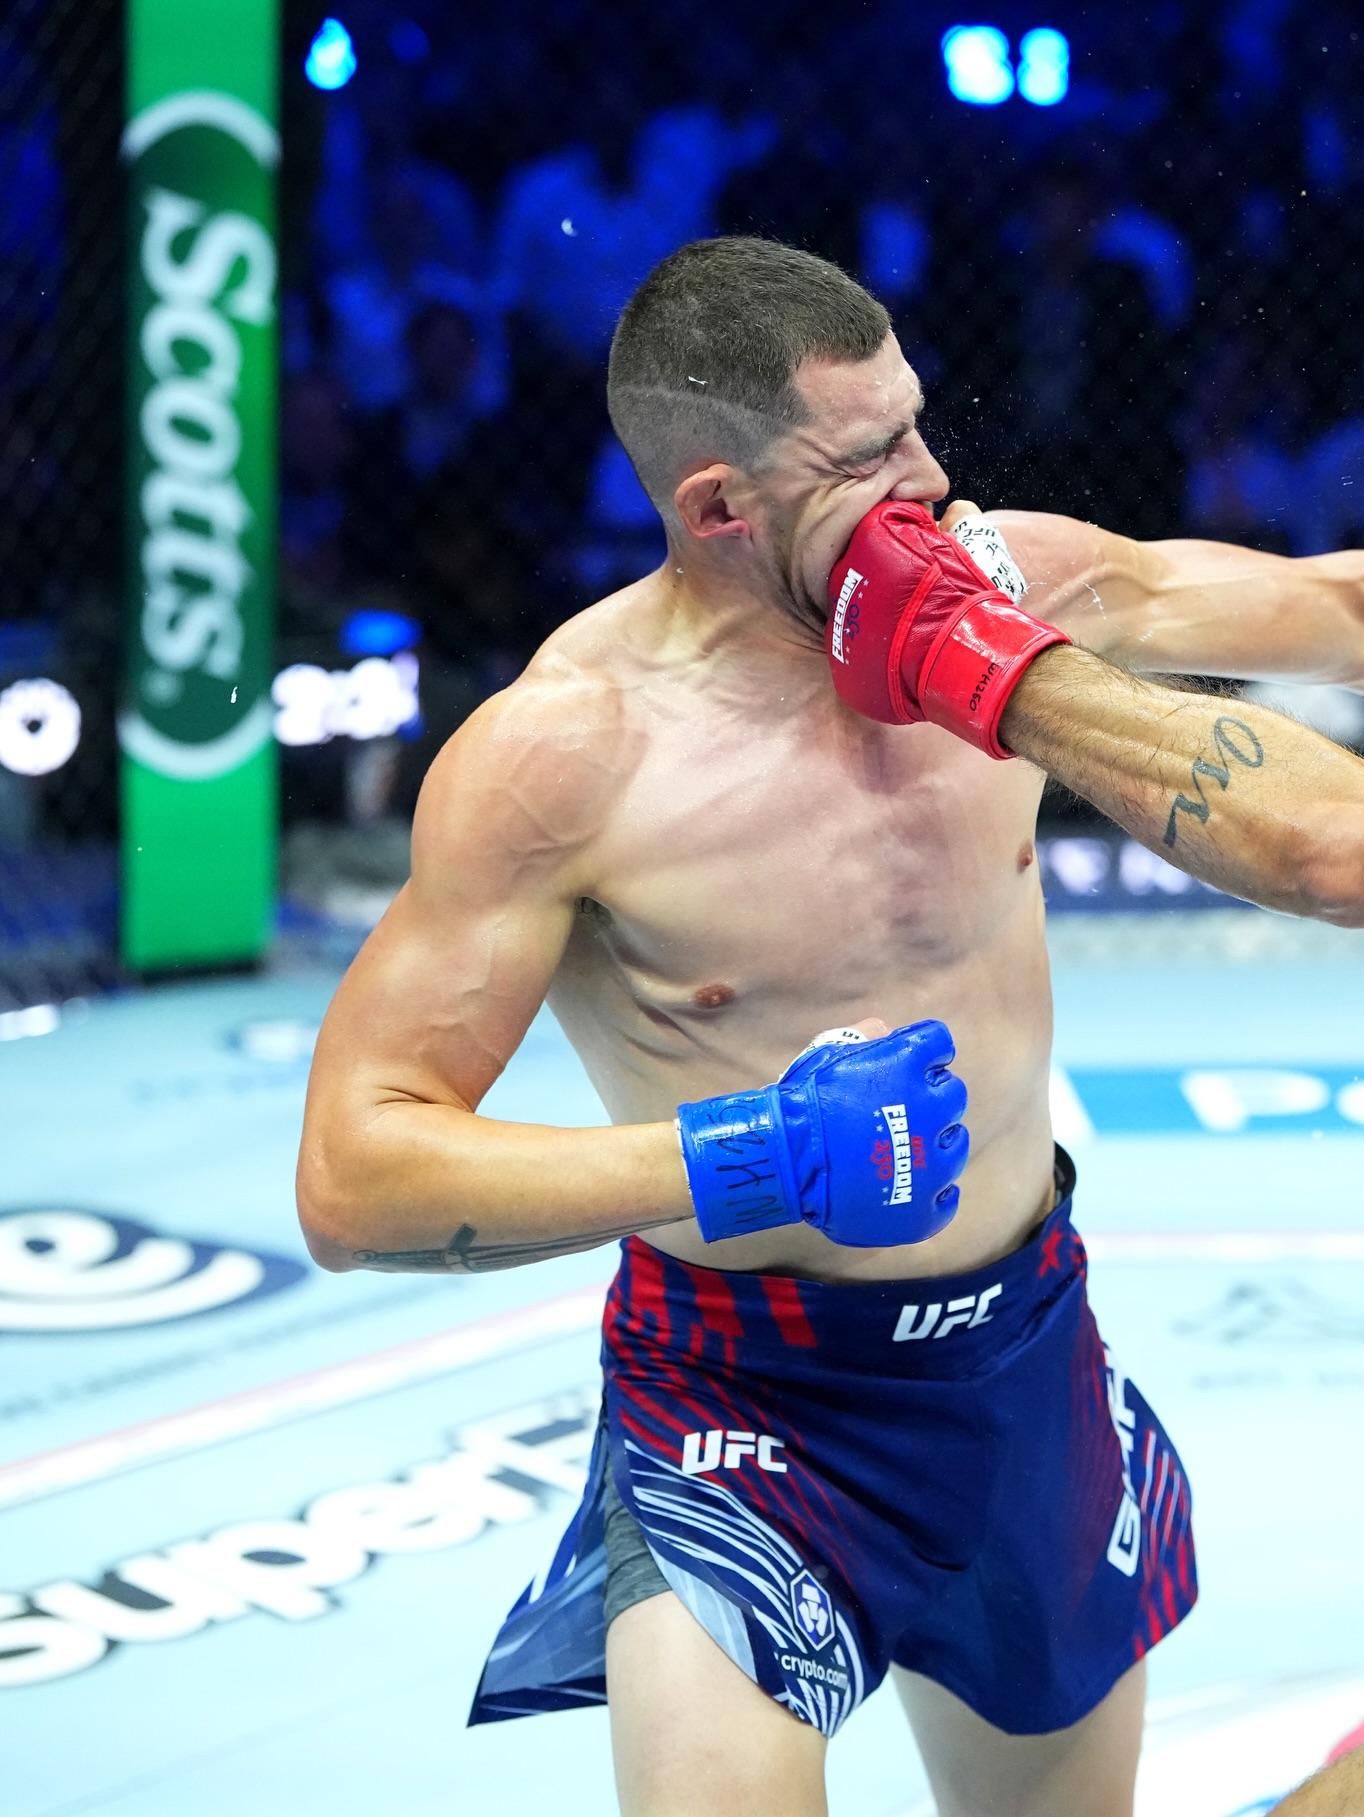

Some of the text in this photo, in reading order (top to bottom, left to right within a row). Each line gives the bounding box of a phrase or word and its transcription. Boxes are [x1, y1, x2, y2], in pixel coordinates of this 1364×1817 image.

[142, 187, 277, 680] Scotts
[831, 567, 864, 664] FREEDOM
[882, 1104, 912, 1205] FREEDOM
[892, 1283, 1003, 1342] UFC
[681, 1429, 788, 1475] UFC
[780, 1653, 849, 1691] crypto.com
